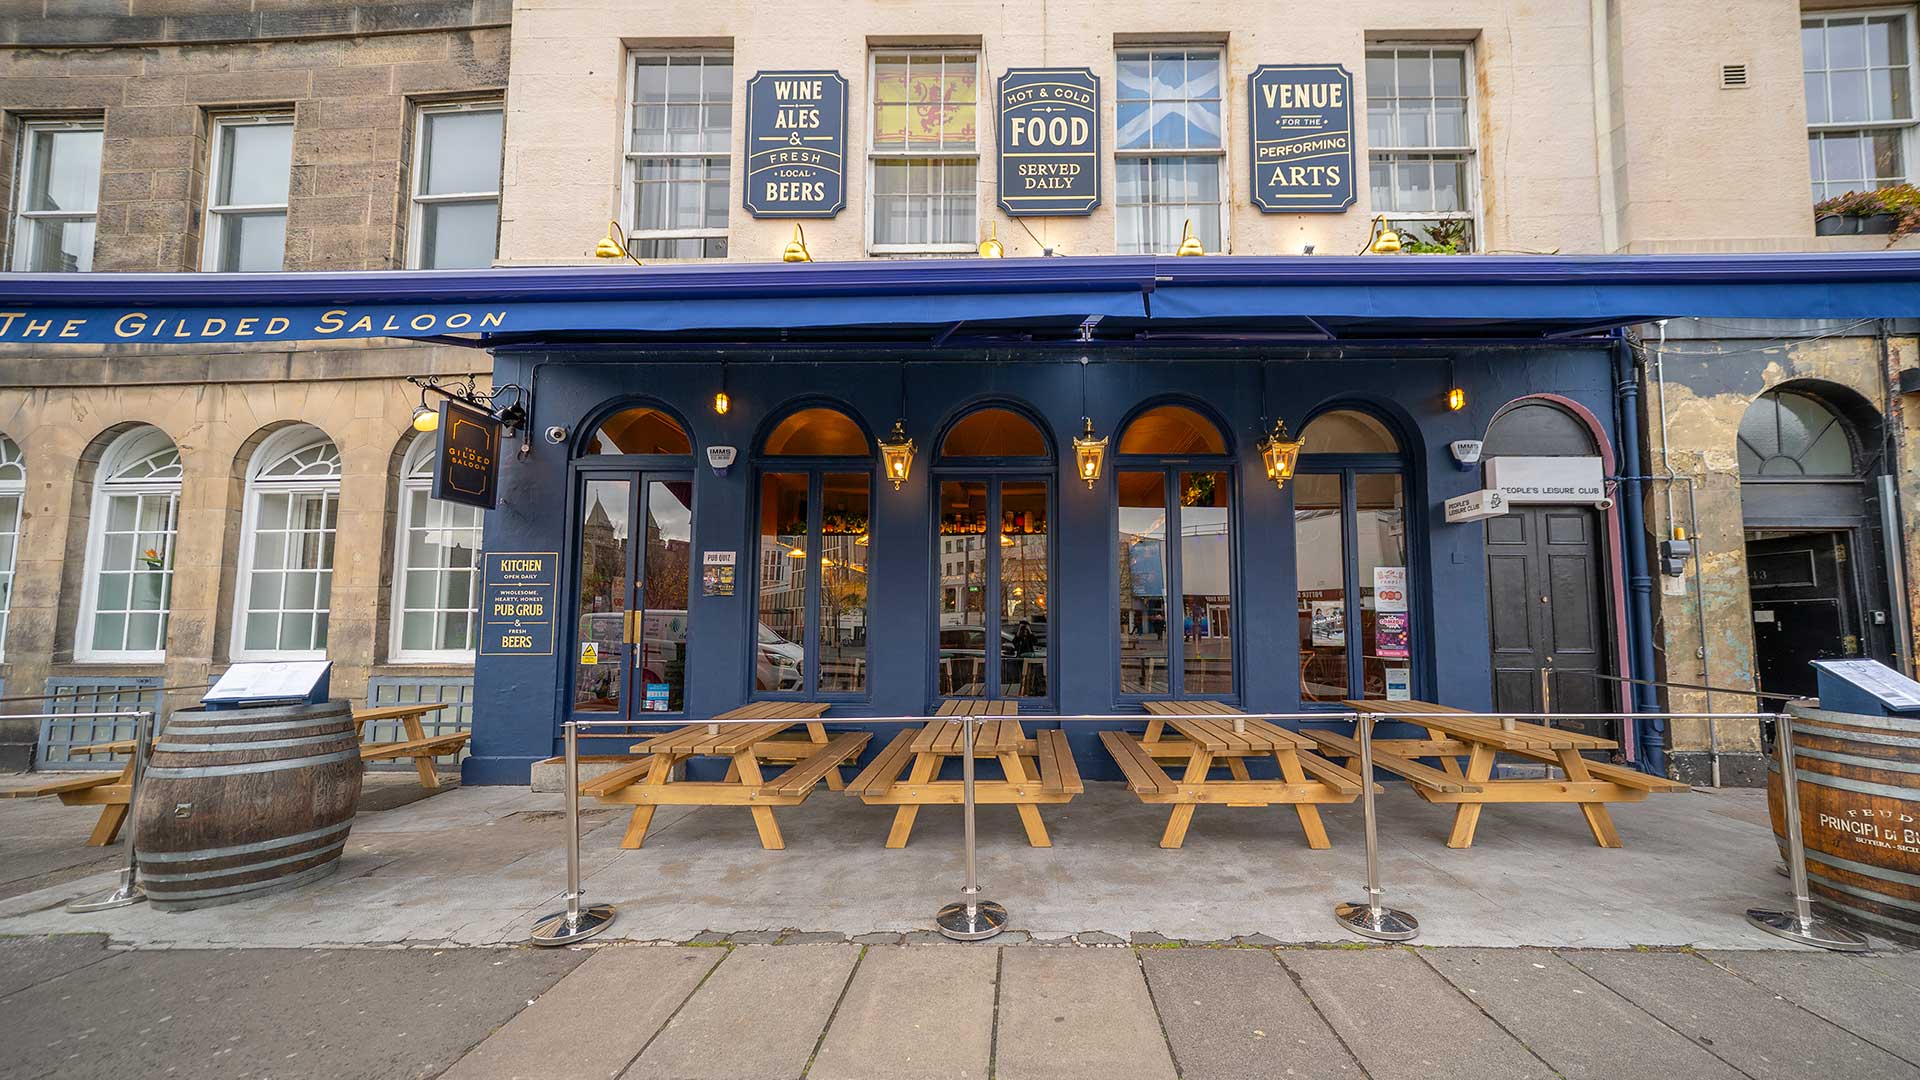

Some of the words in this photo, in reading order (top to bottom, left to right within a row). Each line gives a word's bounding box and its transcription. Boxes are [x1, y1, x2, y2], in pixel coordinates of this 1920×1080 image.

[774, 81, 823, 100] WINE
[1007, 89, 1034, 105] HOT
[1040, 87, 1049, 98] &
[1054, 88, 1090, 104] COLD
[1262, 83, 1344, 109] VENUE
[774, 110, 820, 129] ALES
[790, 132, 802, 146] &
[1011, 117, 1089, 147] FOOD
[1259, 137, 1347, 158] PERFORMING
[770, 152, 820, 164] FRESH
[780, 170, 811, 178] LOCAL
[1018, 164, 1081, 176] SERVED
[1268, 165, 1341, 187] ARTS
[1024, 177, 1075, 190] DAILY
[766, 182, 825, 202] BEERS
[0, 312, 88, 338] THE
[114, 312, 290, 338] GILDED
[313, 309, 507, 335] SALOON
[448, 447, 490, 466] GILDED
[464, 447, 477, 455] THE
[451, 457, 487, 472] SALOON
[1542, 487, 1574, 495] LEISURE
[1578, 487, 1600, 495] CLUB
[1448, 499, 1470, 509] PEOPLE'S
[1448, 506, 1467, 516] LEISURE
[1467, 503, 1480, 512] CLUB
[707, 554, 718, 562] PUB
[718, 554, 731, 562] QUIZ
[501, 559, 542, 572] KITCHEN
[493, 603, 515, 617] PUB
[515, 603, 544, 617] GRUB
[514, 619, 521, 627] &
[501, 636, 533, 648] BEERS
[1819, 813, 1879, 838] PRINCIPI
